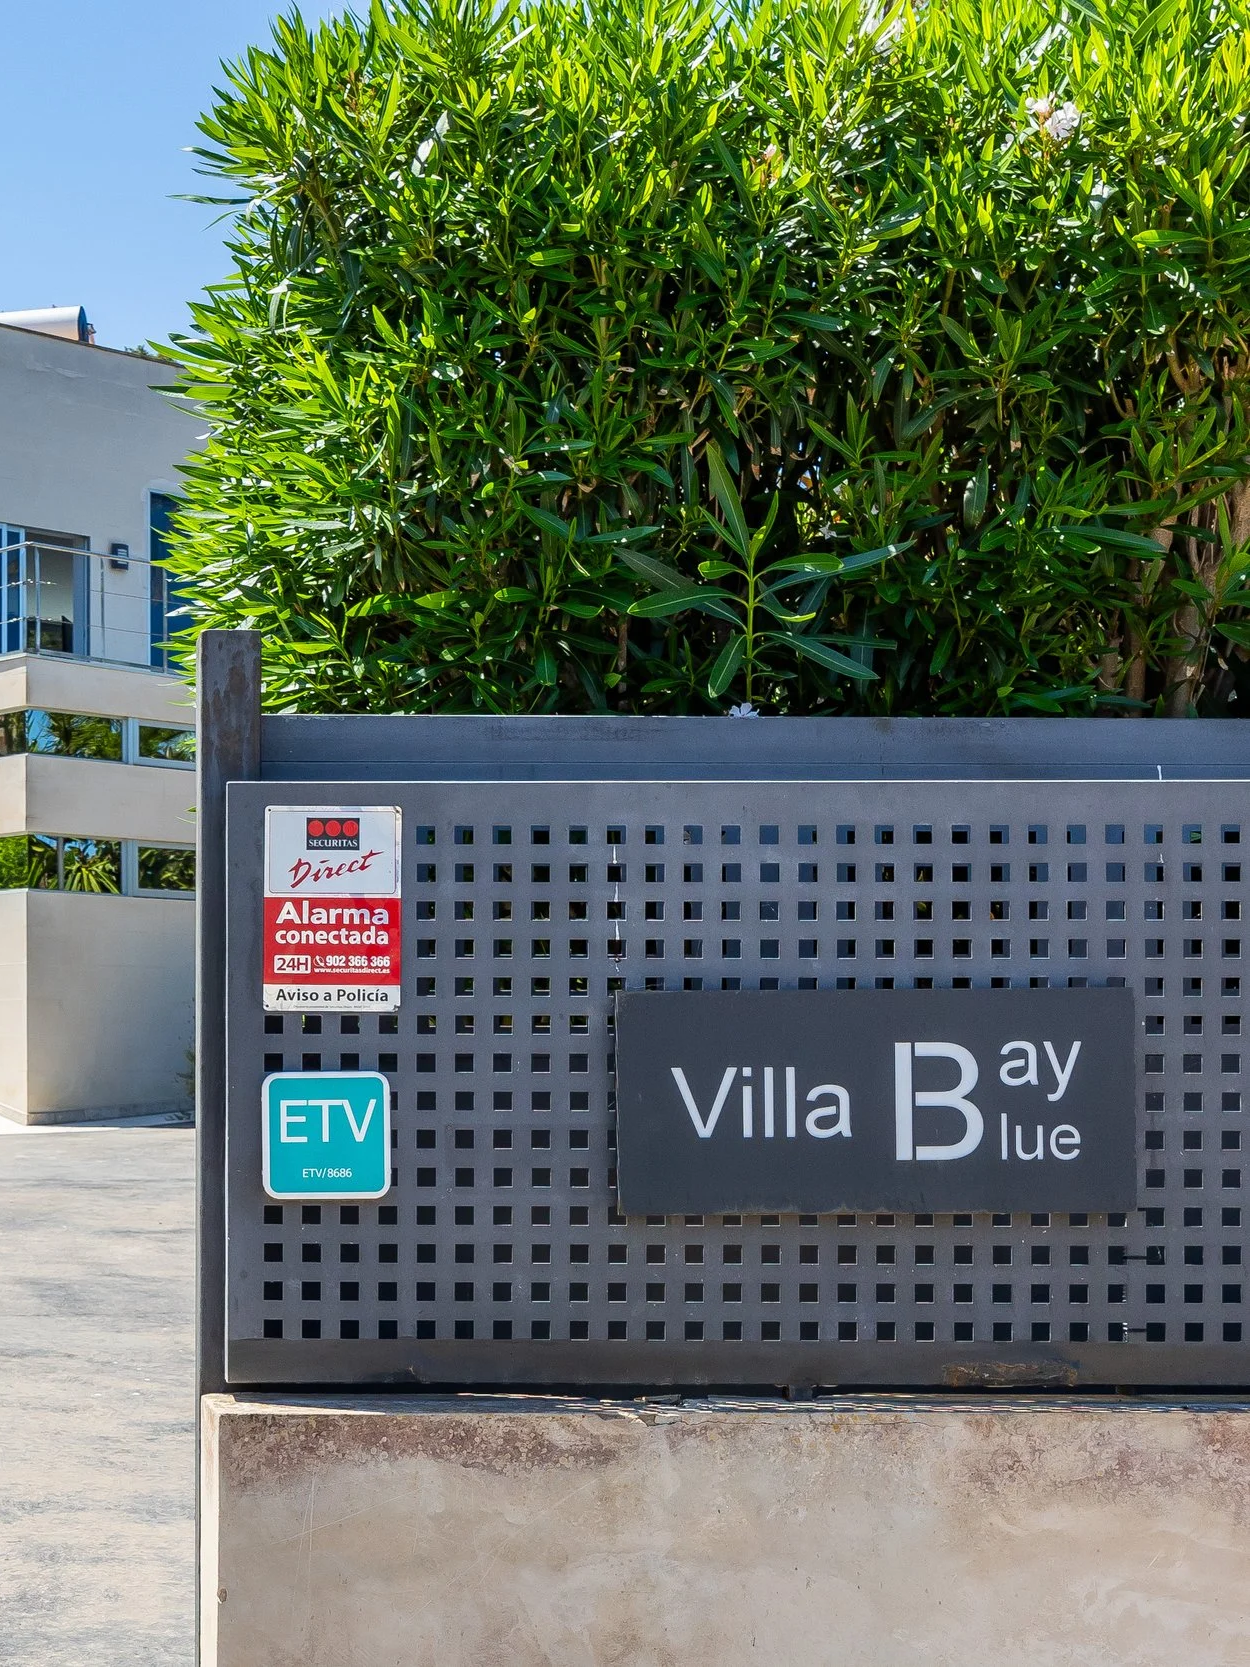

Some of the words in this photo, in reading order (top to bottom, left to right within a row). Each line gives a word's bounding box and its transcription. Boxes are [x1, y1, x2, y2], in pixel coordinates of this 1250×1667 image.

[308, 839, 358, 847] SECURITAS
[288, 850, 384, 889] Direct
[275, 900, 389, 925] Alarma
[275, 926, 389, 945] conectada
[276, 957, 309, 971] 24H
[325, 955, 346, 967] 902
[348, 955, 368, 967] 366
[370, 955, 391, 967] 366
[275, 988, 319, 1002] Aviso
[323, 991, 332, 1002] a
[337, 988, 389, 1002] Policía
[670, 1067, 853, 1139] Villa
[280, 1099, 377, 1143] ETV
[302, 1167, 353, 1178] ETV/8686
